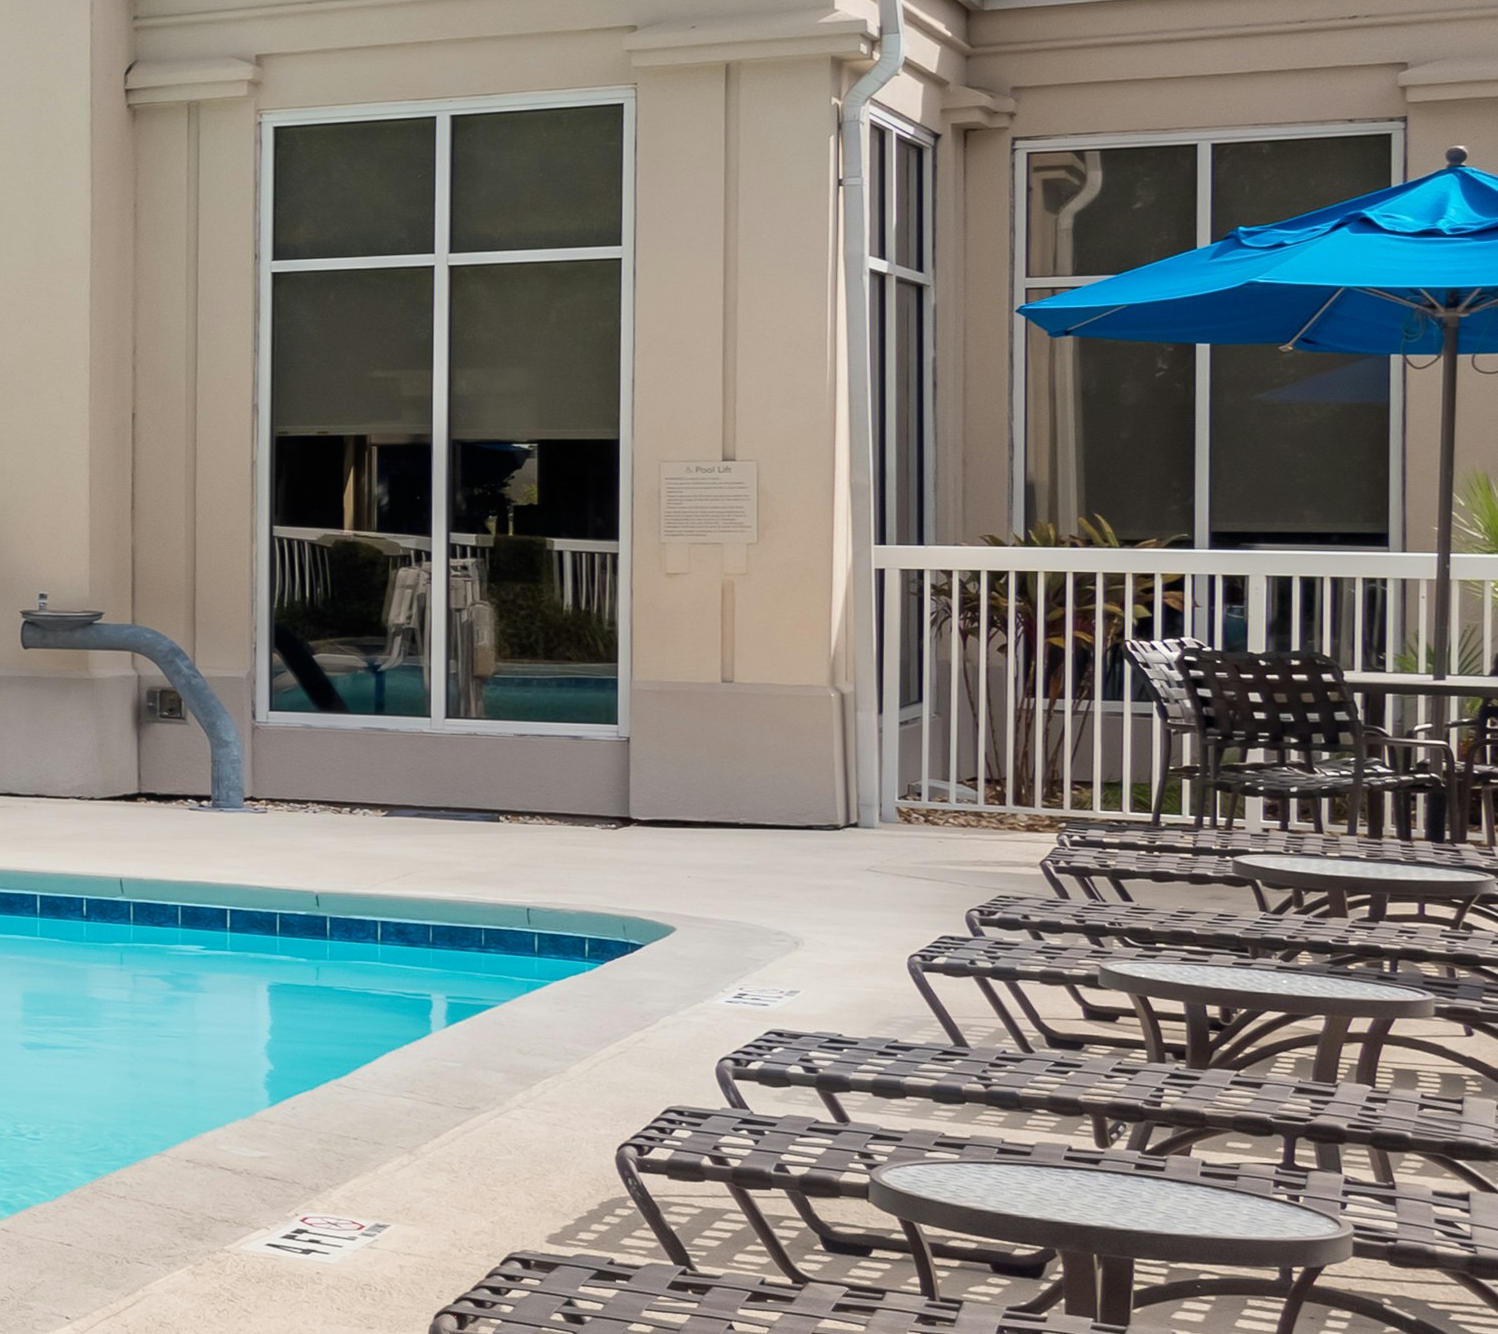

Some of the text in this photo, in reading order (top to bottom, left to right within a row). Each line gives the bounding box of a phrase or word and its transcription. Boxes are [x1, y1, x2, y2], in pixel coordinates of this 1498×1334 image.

[695, 465, 732, 474] Pool Lift
[280, 1228, 359, 1249] FT
[265, 1243, 330, 1255] 4
